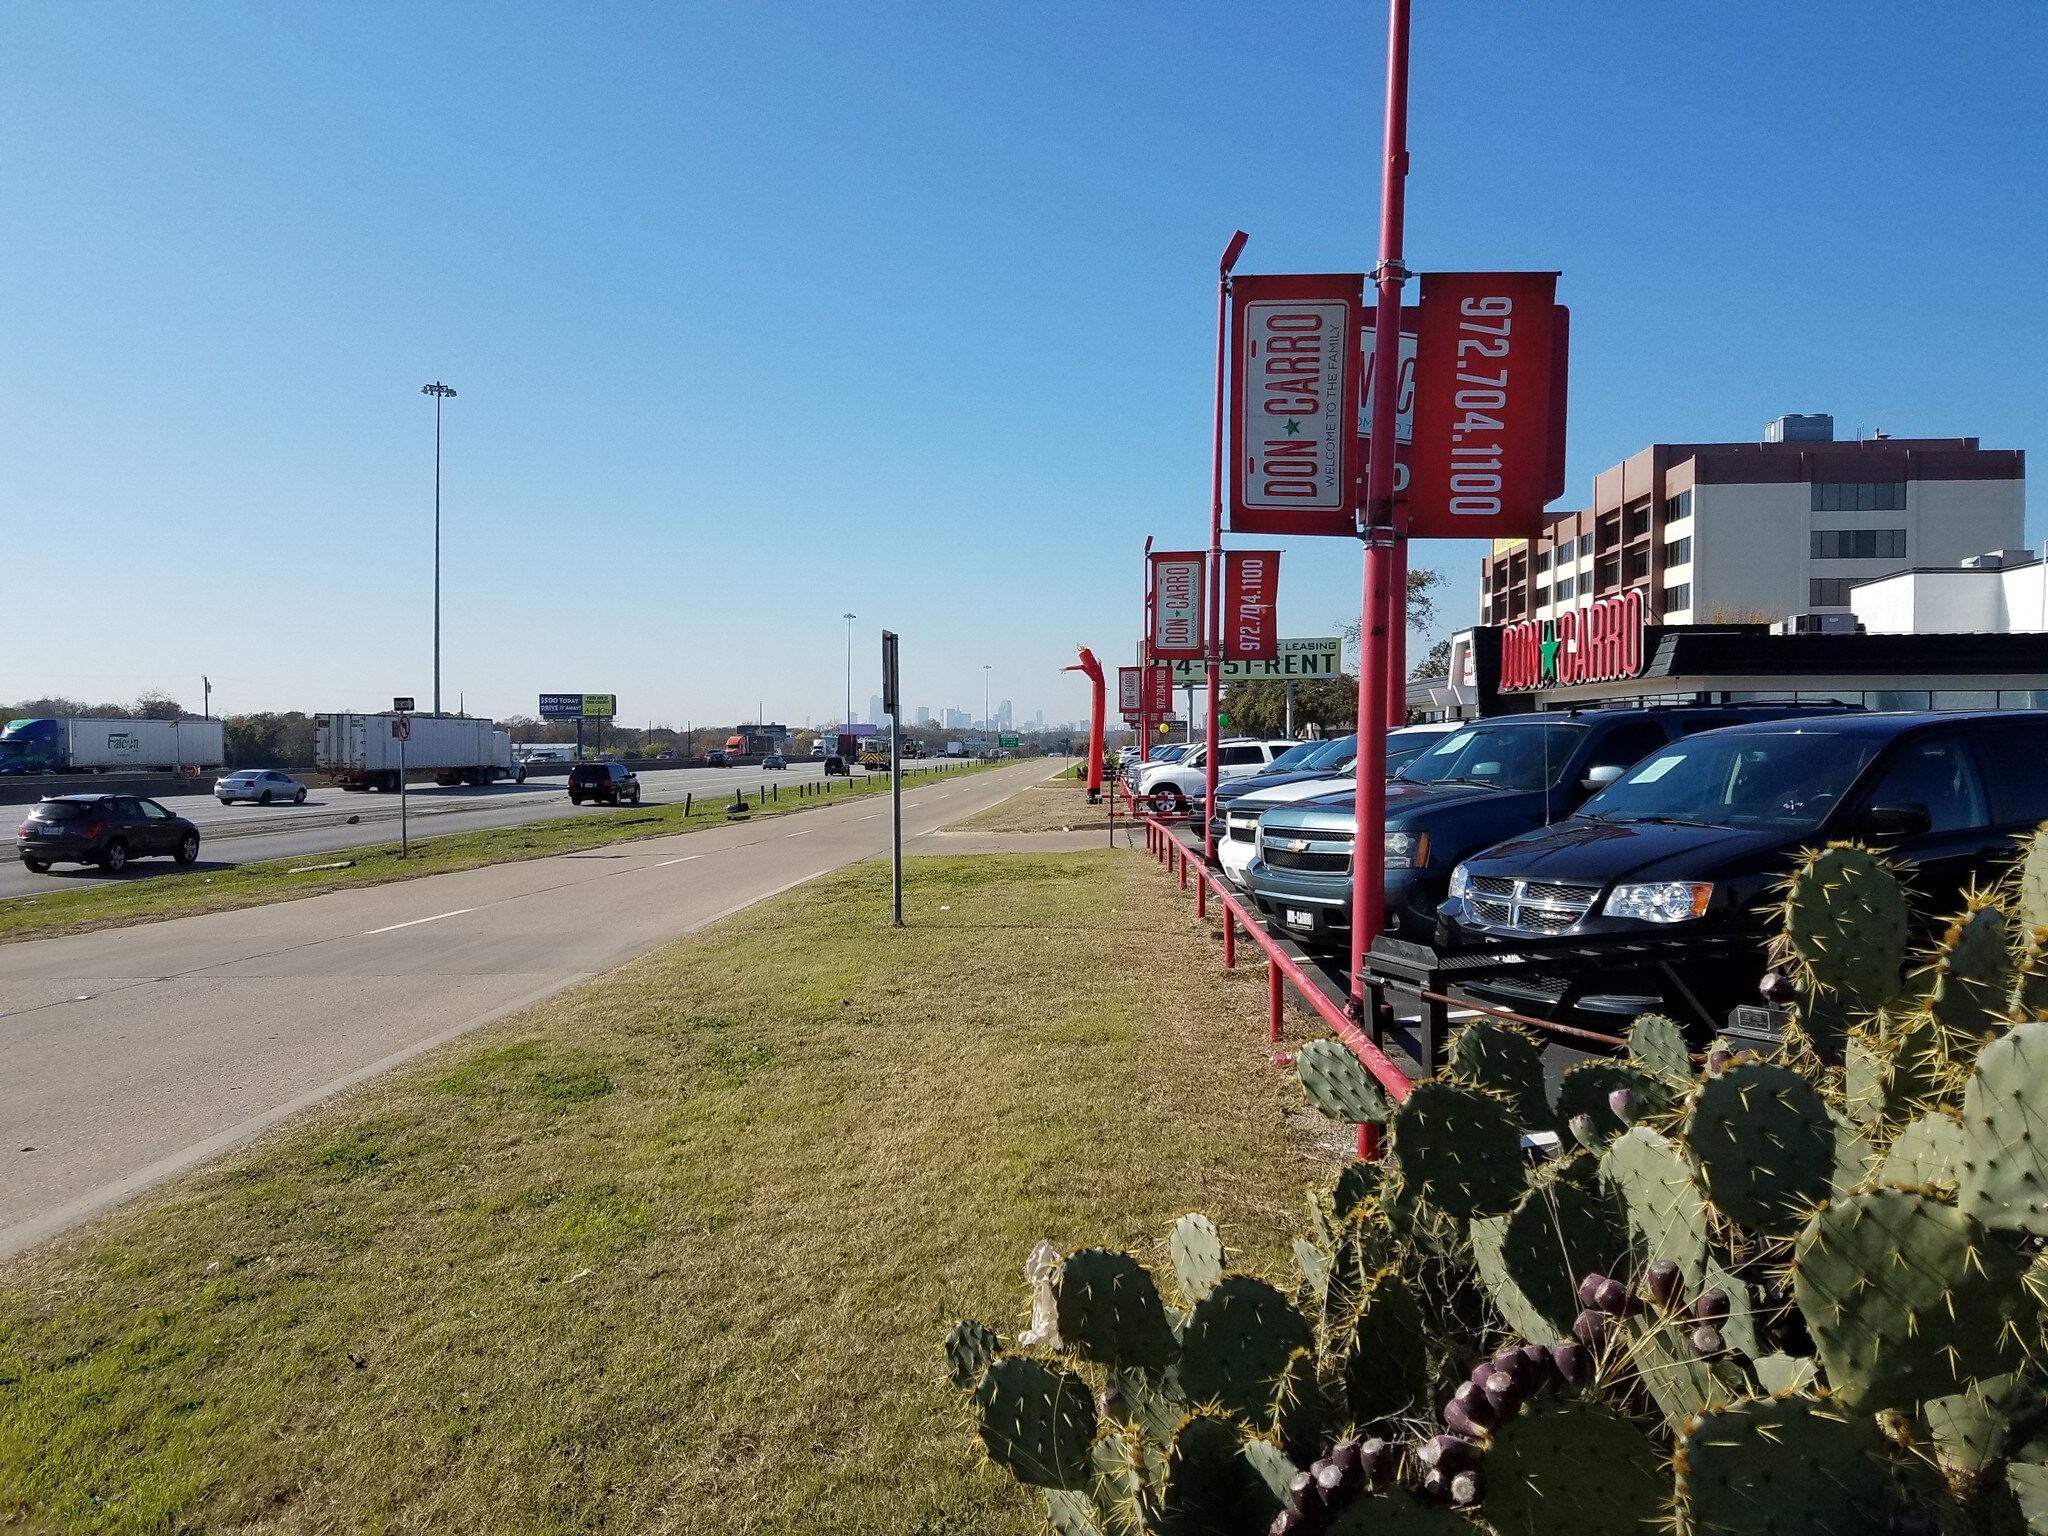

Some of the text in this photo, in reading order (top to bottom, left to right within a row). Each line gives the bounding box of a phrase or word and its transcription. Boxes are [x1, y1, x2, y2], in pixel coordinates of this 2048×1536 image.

[1263, 314, 1323, 497] DON CARRO
[1325, 324, 1340, 488] WELCOME TO THE FAMILY
[1449, 296, 1513, 516] 972.704.1100
[1165, 567, 1190, 643] DON CARRO
[1240, 559, 1263, 650] 972.704.1100
[1285, 642, 1337, 650] LEASING
[1501, 589, 1643, 691] DON CARRO
